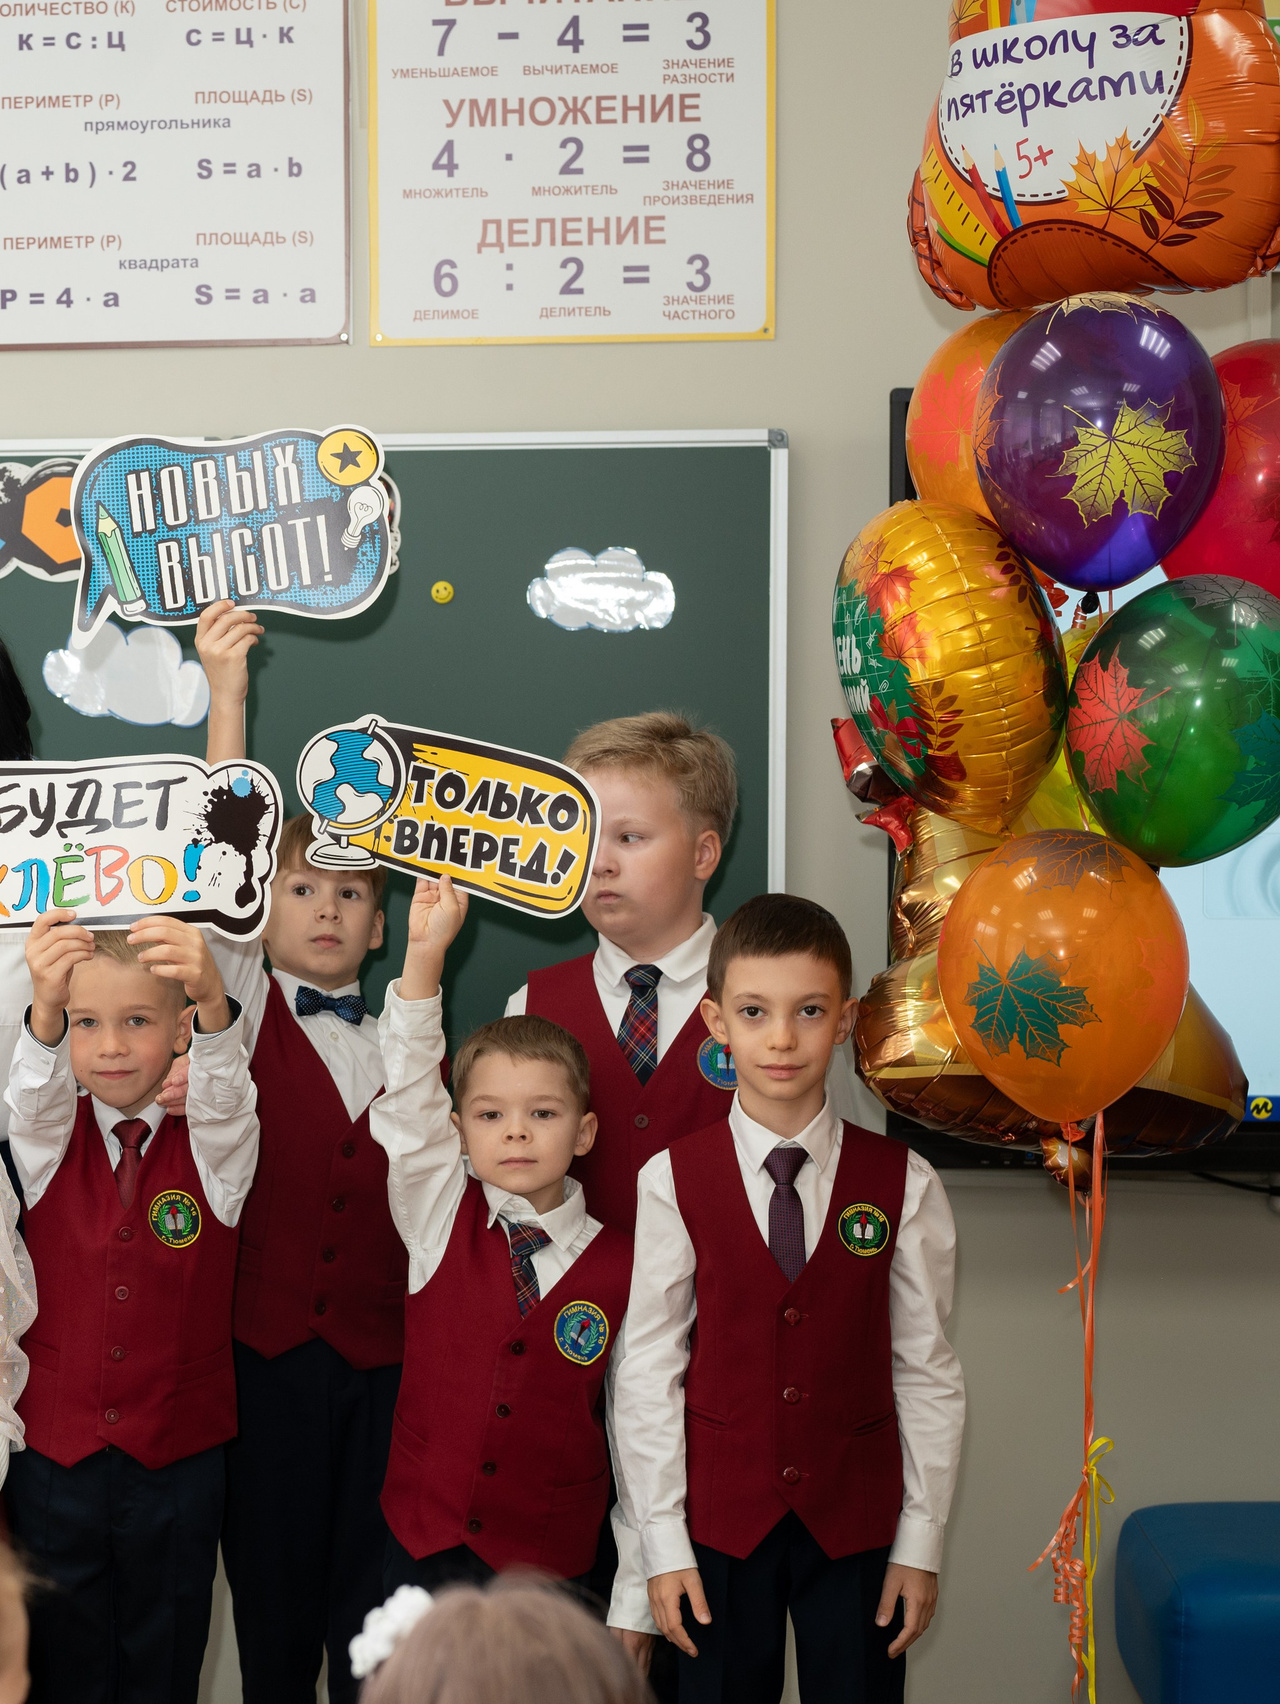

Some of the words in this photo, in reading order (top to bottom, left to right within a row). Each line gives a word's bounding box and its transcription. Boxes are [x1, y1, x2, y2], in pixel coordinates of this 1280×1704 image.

[431, 18, 458, 57] 7
[556, 14, 585, 54] 4
[685, 10, 712, 52] 3
[971, 28, 1097, 70] школу
[1109, 22, 1166, 50] за
[391, 65, 499, 80] УМЕНЬШАЕМОЕ
[522, 62, 619, 76] ВЫЧИТАЕМОЕ
[662, 57, 735, 70] ЗНАЧЕНИЕ
[662, 72, 735, 85] РАЗНОСТИ
[1, 94, 94, 110] ПЕРИМЕТР
[194, 89, 286, 106] ПЛОЩАДЬ
[946, 69, 1166, 128] пятёрками
[442, 92, 702, 129] УМНОЖЕНИЕ
[84, 117, 232, 136] прямоугольника
[431, 139, 460, 178] 4
[558, 136, 584, 176] 2
[685, 132, 712, 173] 8
[1015, 137, 1054, 181] 5+
[121, 160, 137, 182] 2
[402, 186, 489, 200] МНОЖИТЕЛЬ
[531, 184, 619, 197] МНОЖИТЕЛЬ
[662, 178, 735, 192] ЗНАЧЕНИЕ
[642, 192, 754, 207] ПРОИЗВЕДЕНИЯ
[2, 235, 95, 251] ПЕРИМЕТР
[196, 230, 287, 248] ПЛОЩАДЬ
[476, 214, 667, 255] ДЕЛЕНИЕ
[118, 257, 200, 273] квадрата
[433, 258, 459, 298] 6
[558, 256, 585, 296] 2
[685, 253, 712, 294] 3
[55, 286, 74, 309] 4
[662, 294, 735, 306] ЗНАЧЕНИЕ
[412, 308, 480, 323] ДЕЛИМОЕ
[538, 305, 612, 320] ДЕЛИТЕЛЬ
[662, 308, 736, 321] ЧАСТНОГО
[126, 444, 302, 534] НОВЫХ
[157, 514, 333, 610] ВЫСОТ!
[835, 633, 862, 676] ЕНЬ
[409, 767, 580, 834] ТОЛЬКО
[392, 816, 578, 888] ВПЕРЕД!
[701, 1038, 717, 1057] ГИМН
[563, 1305, 602, 1321] ГИМНАЗИЯ
